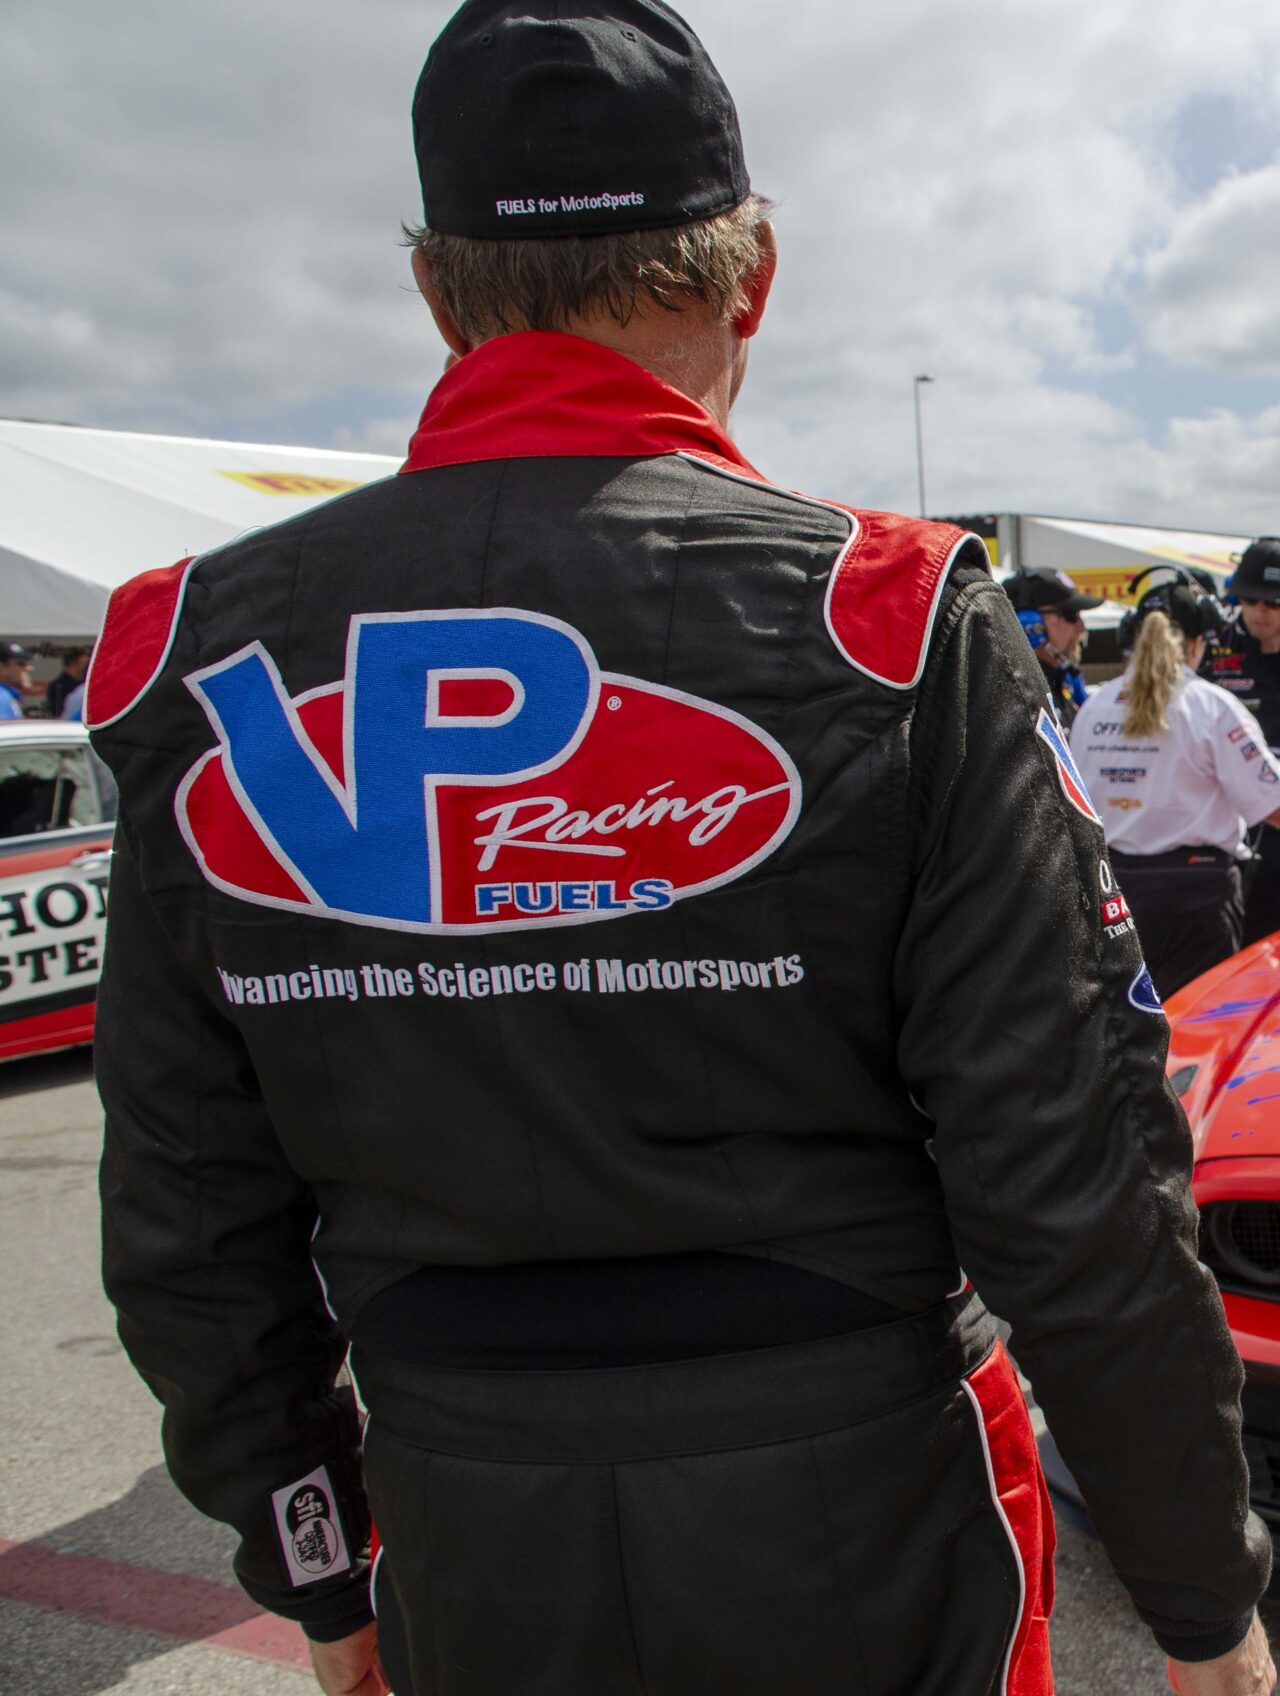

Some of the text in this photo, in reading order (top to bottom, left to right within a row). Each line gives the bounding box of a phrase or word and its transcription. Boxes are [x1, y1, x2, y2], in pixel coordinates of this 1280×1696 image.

[496, 192, 645, 215] FUELS for MotorSports
[183, 607, 600, 926] VP
[474, 780, 794, 872] Racing
[475, 878, 677, 916] FUELS
[216, 953, 805, 1005] vancing the Science of Motorsports
